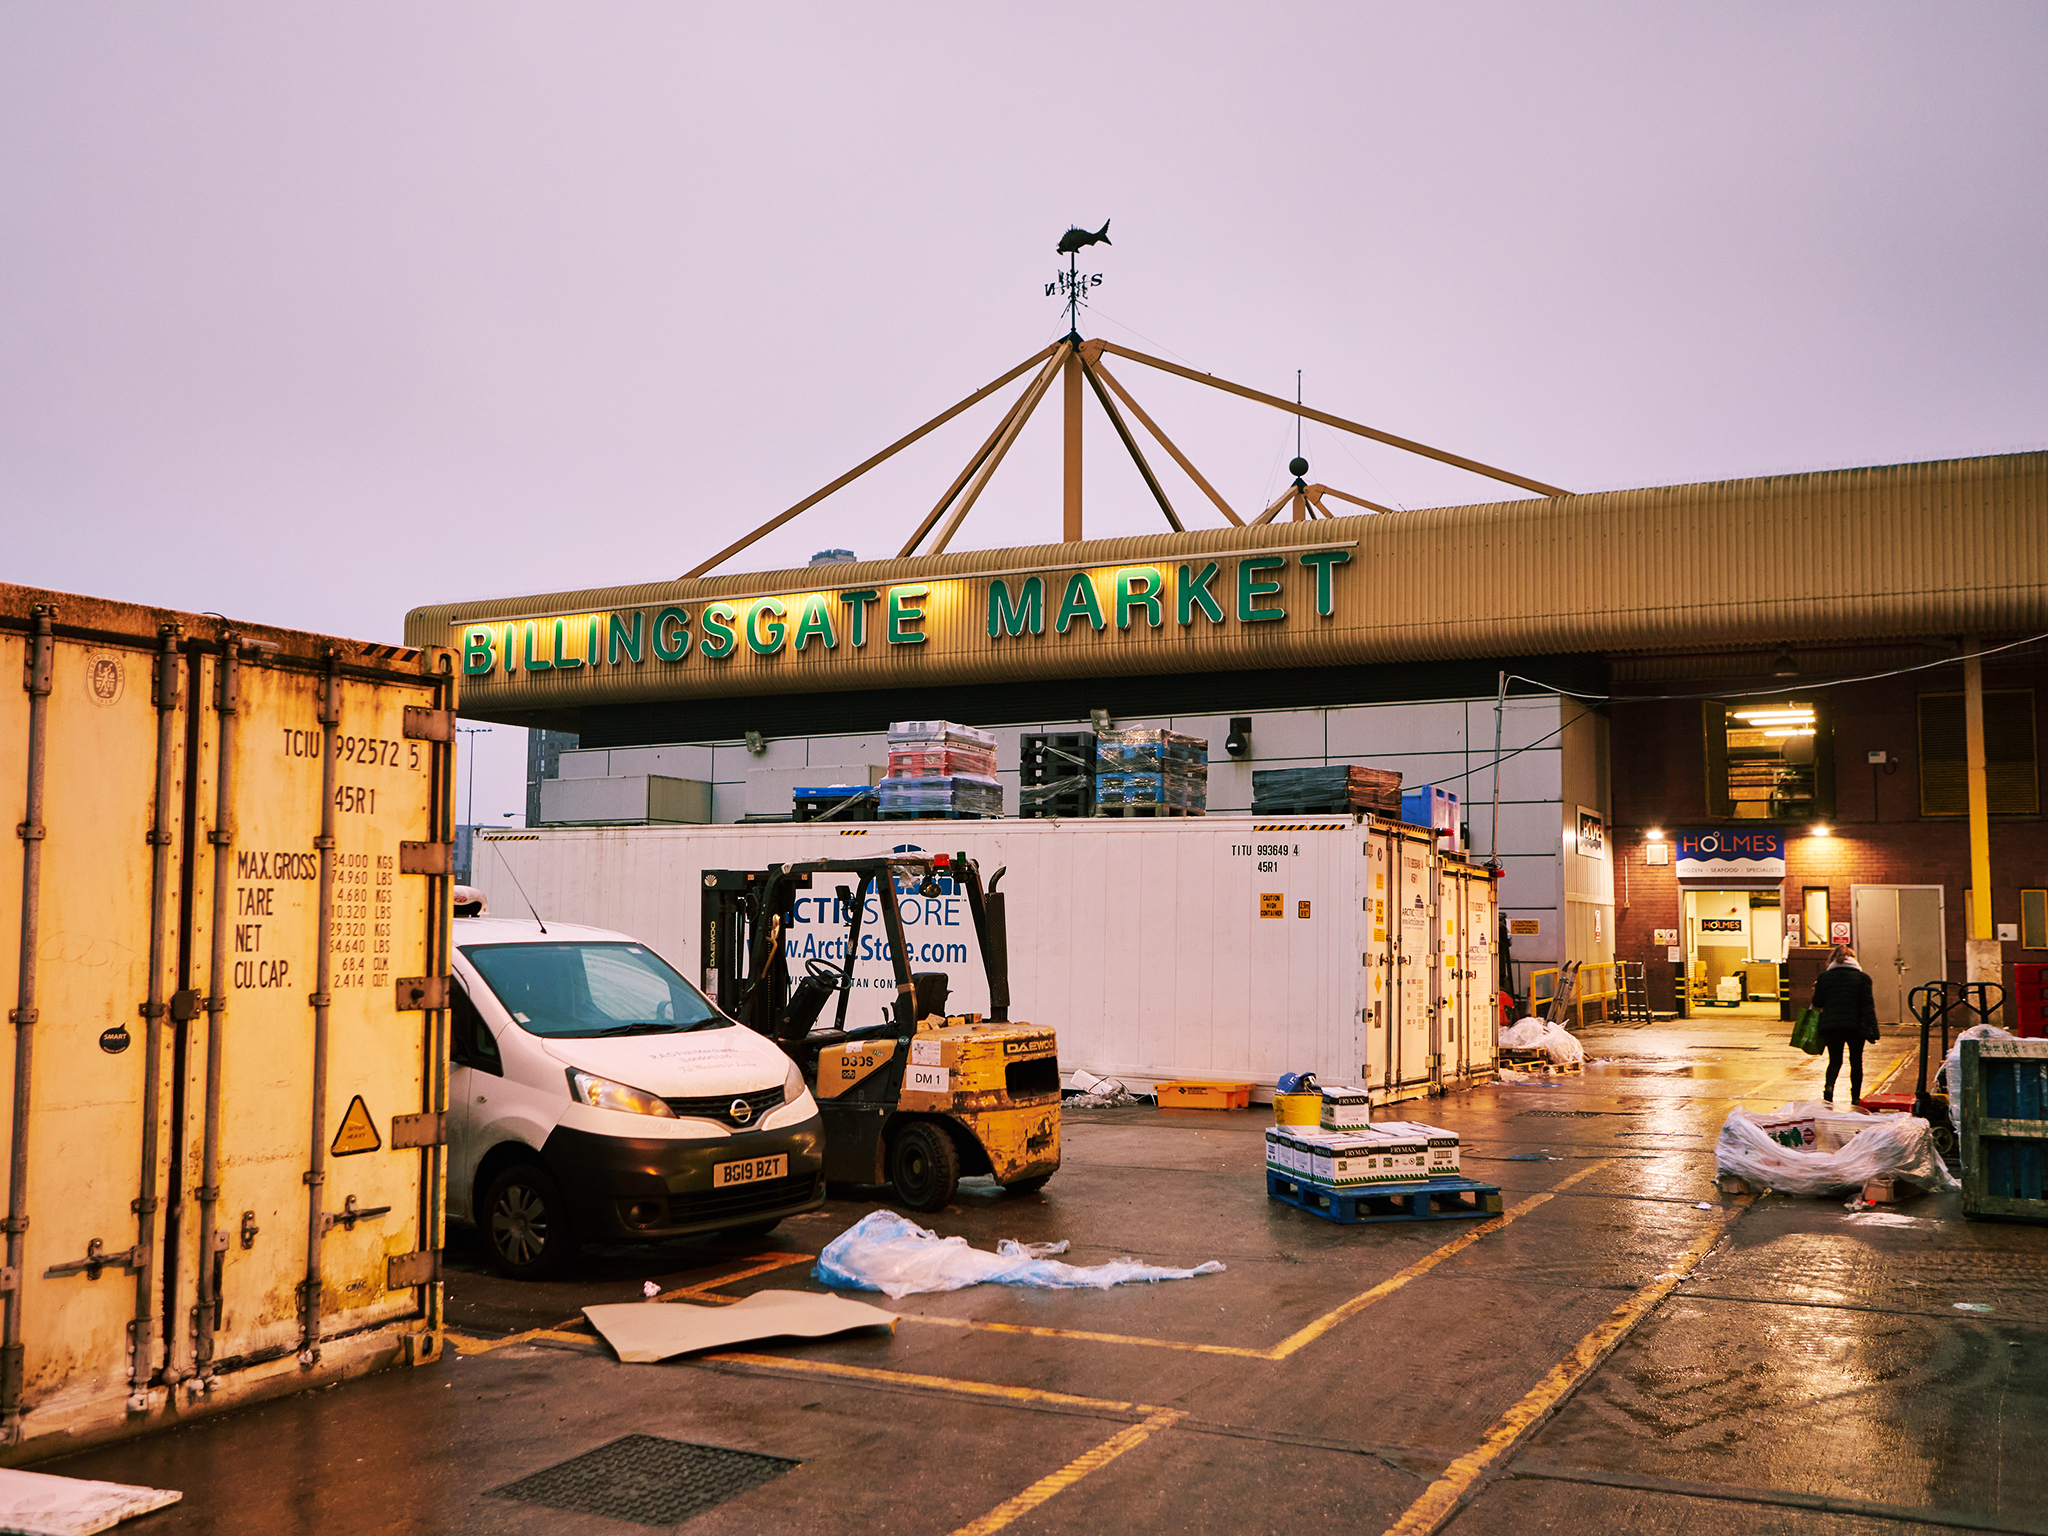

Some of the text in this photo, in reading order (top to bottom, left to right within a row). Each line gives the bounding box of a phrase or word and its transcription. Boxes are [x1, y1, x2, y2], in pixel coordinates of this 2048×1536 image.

[463, 550, 1351, 676] BILLINGSGATE MARKET
[284, 728, 419, 769] TCIU 992572 5
[335, 785, 375, 814] 45R1
[1683, 831, 1777, 853] HOLMES
[1232, 844, 1299, 856] TITU 993649 4
[376, 855, 393, 869] KGS
[1257, 861, 1278, 872] 45R1
[237, 887, 274, 916] TARE
[1703, 921, 1740, 929] HOLMES
[235, 924, 262, 952] NET
[1006, 1039, 1054, 1054] DAEWOO
[915, 1073, 940, 1084] DM 1
[1338, 1097, 1365, 1105] FRYMAX
[1390, 1145, 1416, 1153] FRYMAX
[1429, 1139, 1455, 1147] FRYMAX
[1344, 1148, 1369, 1157] FRYMAX
[723, 1158, 780, 1183] BG19 BZT
